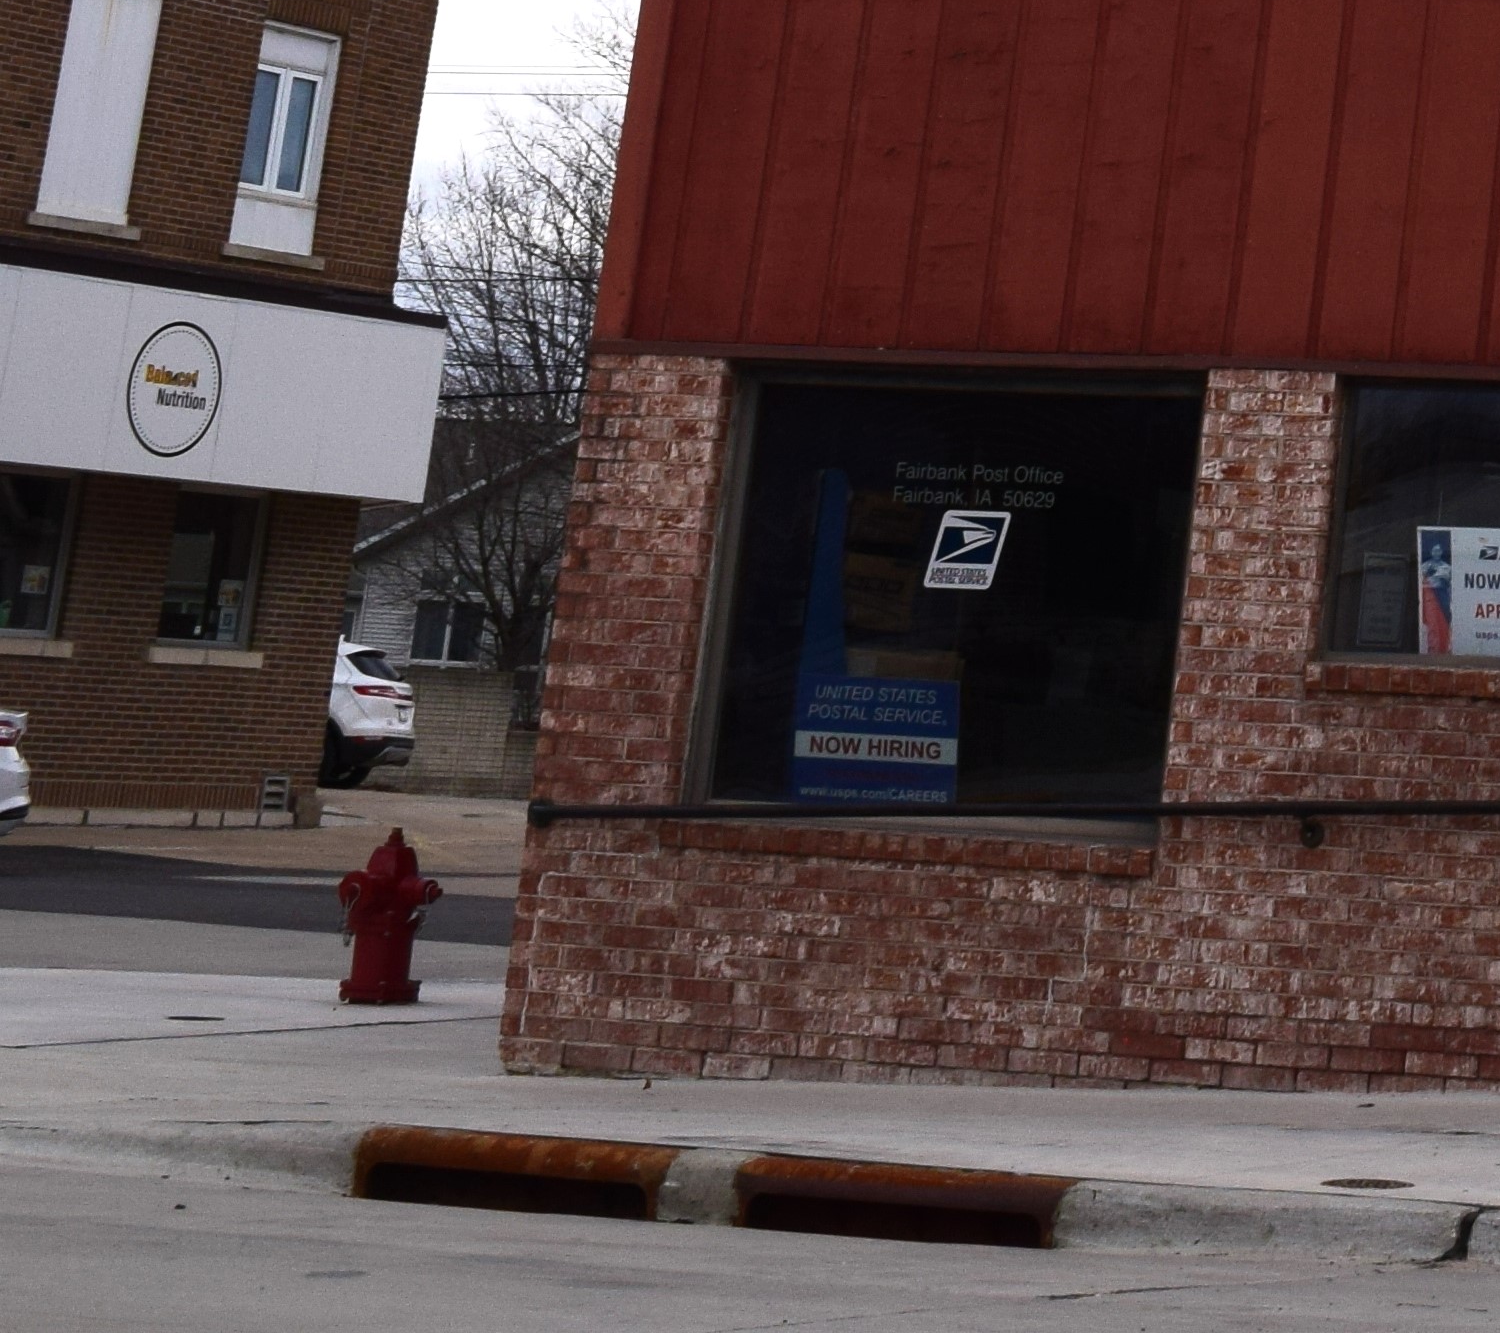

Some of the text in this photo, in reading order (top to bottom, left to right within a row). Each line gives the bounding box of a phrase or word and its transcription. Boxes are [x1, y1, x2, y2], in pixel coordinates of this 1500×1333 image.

[157, 388, 206, 410] Nutrition
[896, 462, 1064, 485] Fairbank Post Office
[893, 485, 1055, 508] Fairbank, IA 50629
[931, 567, 988, 576] UNITED STATES
[1464, 573, 1500, 589] NOW
[815, 684, 937, 705] UNITED STATES
[807, 704, 868, 721] POSTAL
[809, 735, 942, 760] NOW HIRING
[799, 786, 948, 804] www.usps.com/CAREERS
